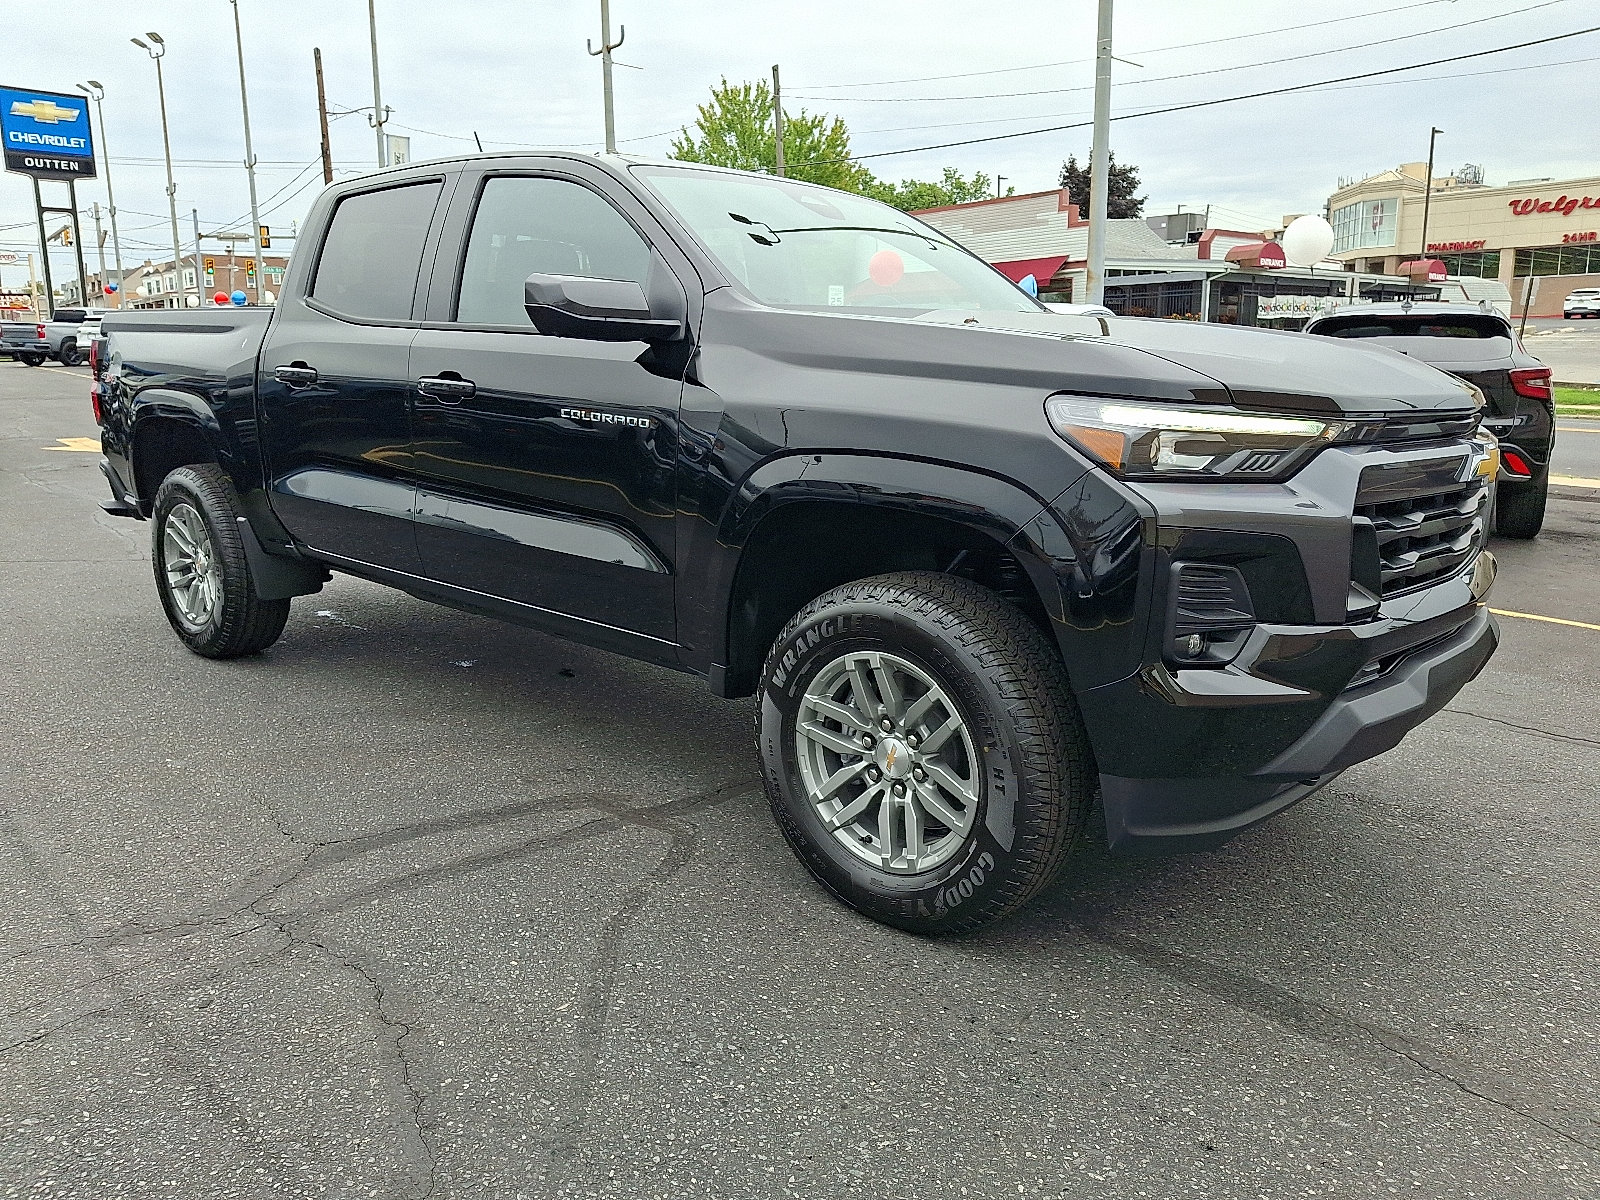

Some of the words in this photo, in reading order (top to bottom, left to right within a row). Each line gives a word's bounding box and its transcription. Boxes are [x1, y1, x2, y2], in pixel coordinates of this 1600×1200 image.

[9, 131, 86, 148] CHEVROLET
[24, 157, 79, 171] OUTTEN
[1562, 231, 1597, 244] 24HR
[1426, 239, 1487, 252] PHARMACY
[1260, 257, 1284, 267] ENTRANCE
[560, 408, 650, 428] COLORADO
[771, 613, 881, 689] WRANGLER
